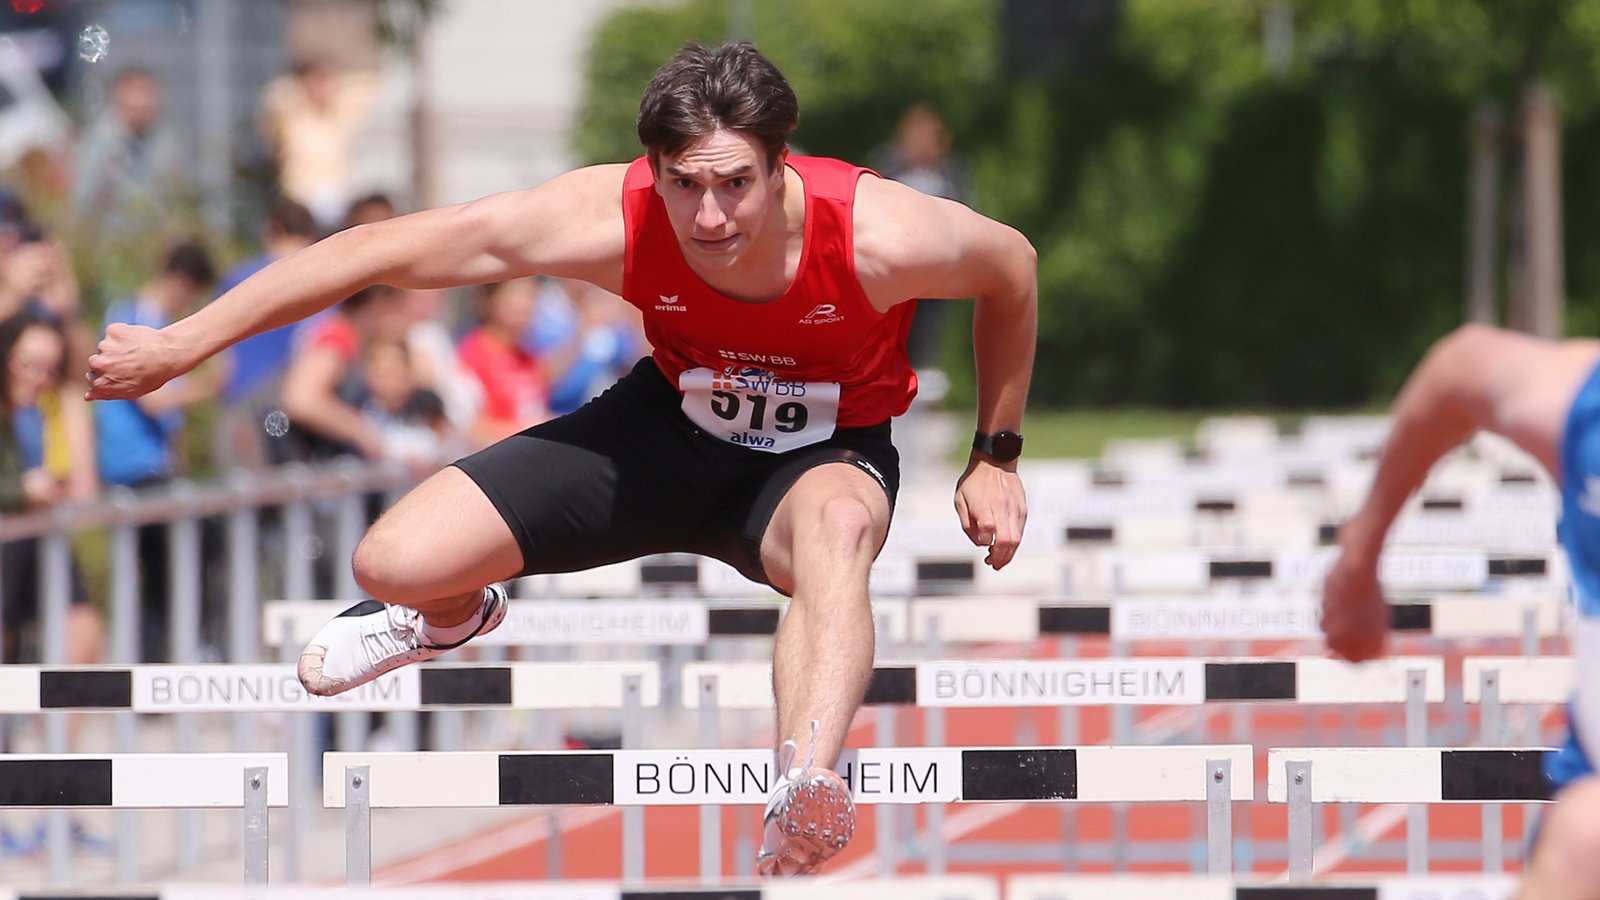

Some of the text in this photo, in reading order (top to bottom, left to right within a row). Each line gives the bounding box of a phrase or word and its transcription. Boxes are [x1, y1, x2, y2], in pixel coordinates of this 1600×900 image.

[654, 304, 687, 312] erima
[814, 315, 845, 325] SPORT
[711, 389, 808, 434] 519
[730, 431, 776, 448] alwa
[935, 668, 1186, 699] BÖNNIGHEIM
